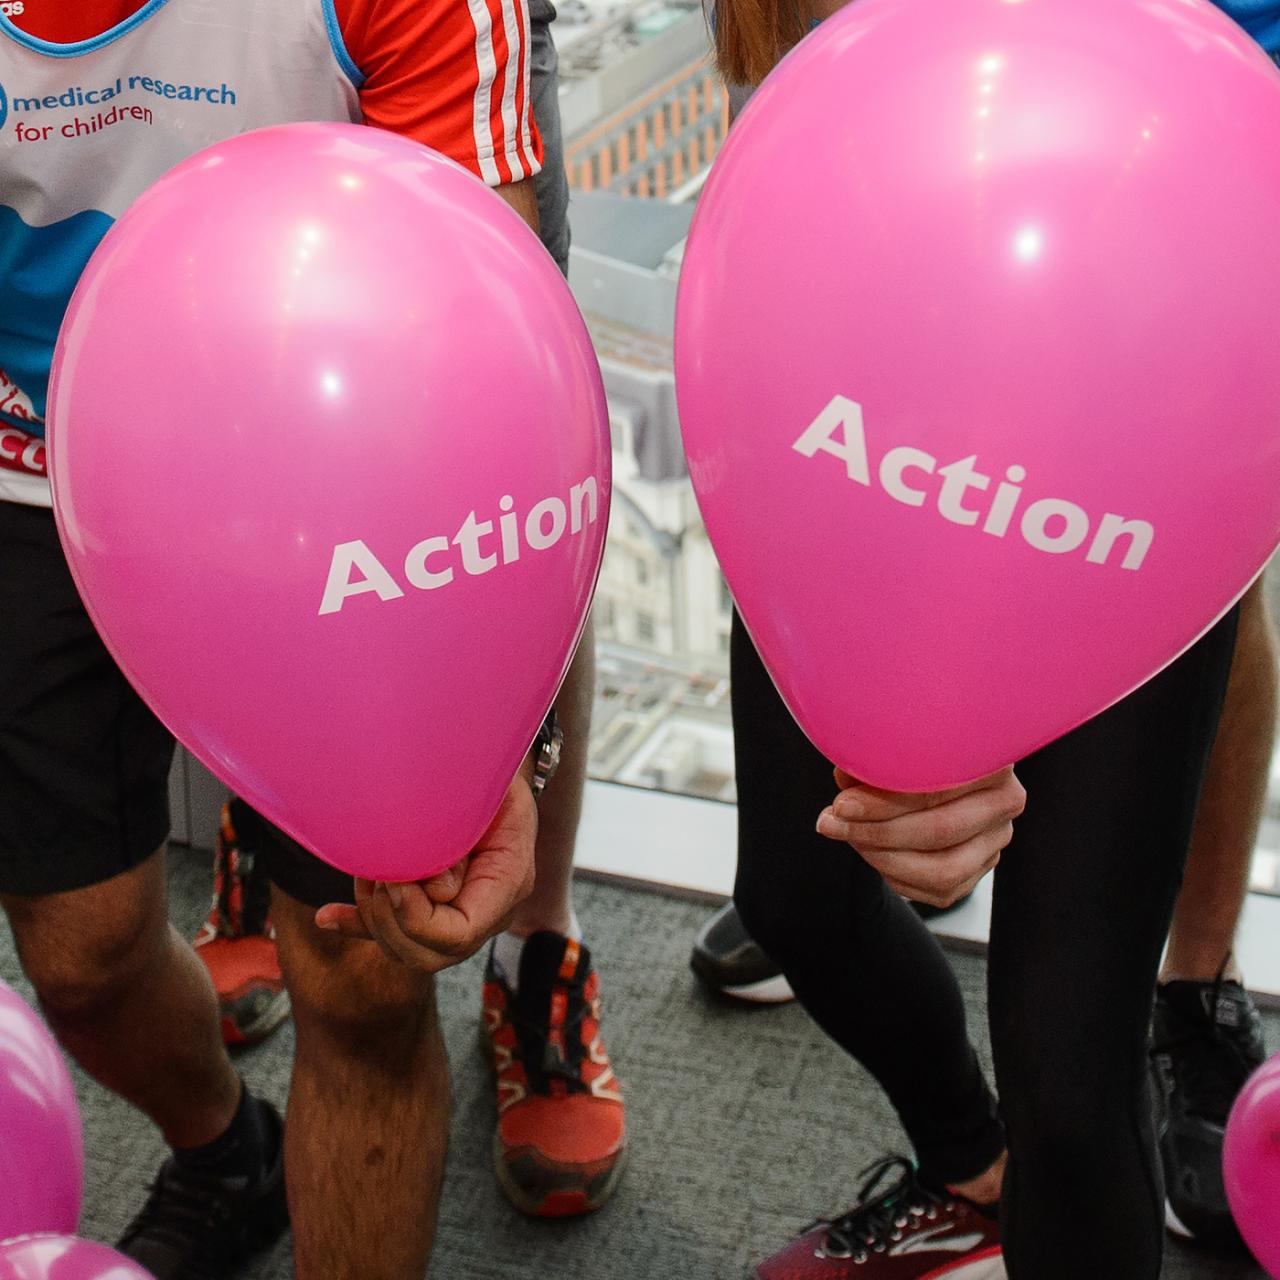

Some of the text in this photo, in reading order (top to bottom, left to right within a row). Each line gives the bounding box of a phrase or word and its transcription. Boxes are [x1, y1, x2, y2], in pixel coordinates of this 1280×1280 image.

[13, 77, 121, 112] medical
[128, 73, 237, 106] research
[15, 104, 153, 143] for children
[791, 394, 1155, 571] Action
[318, 475, 598, 616] Action
